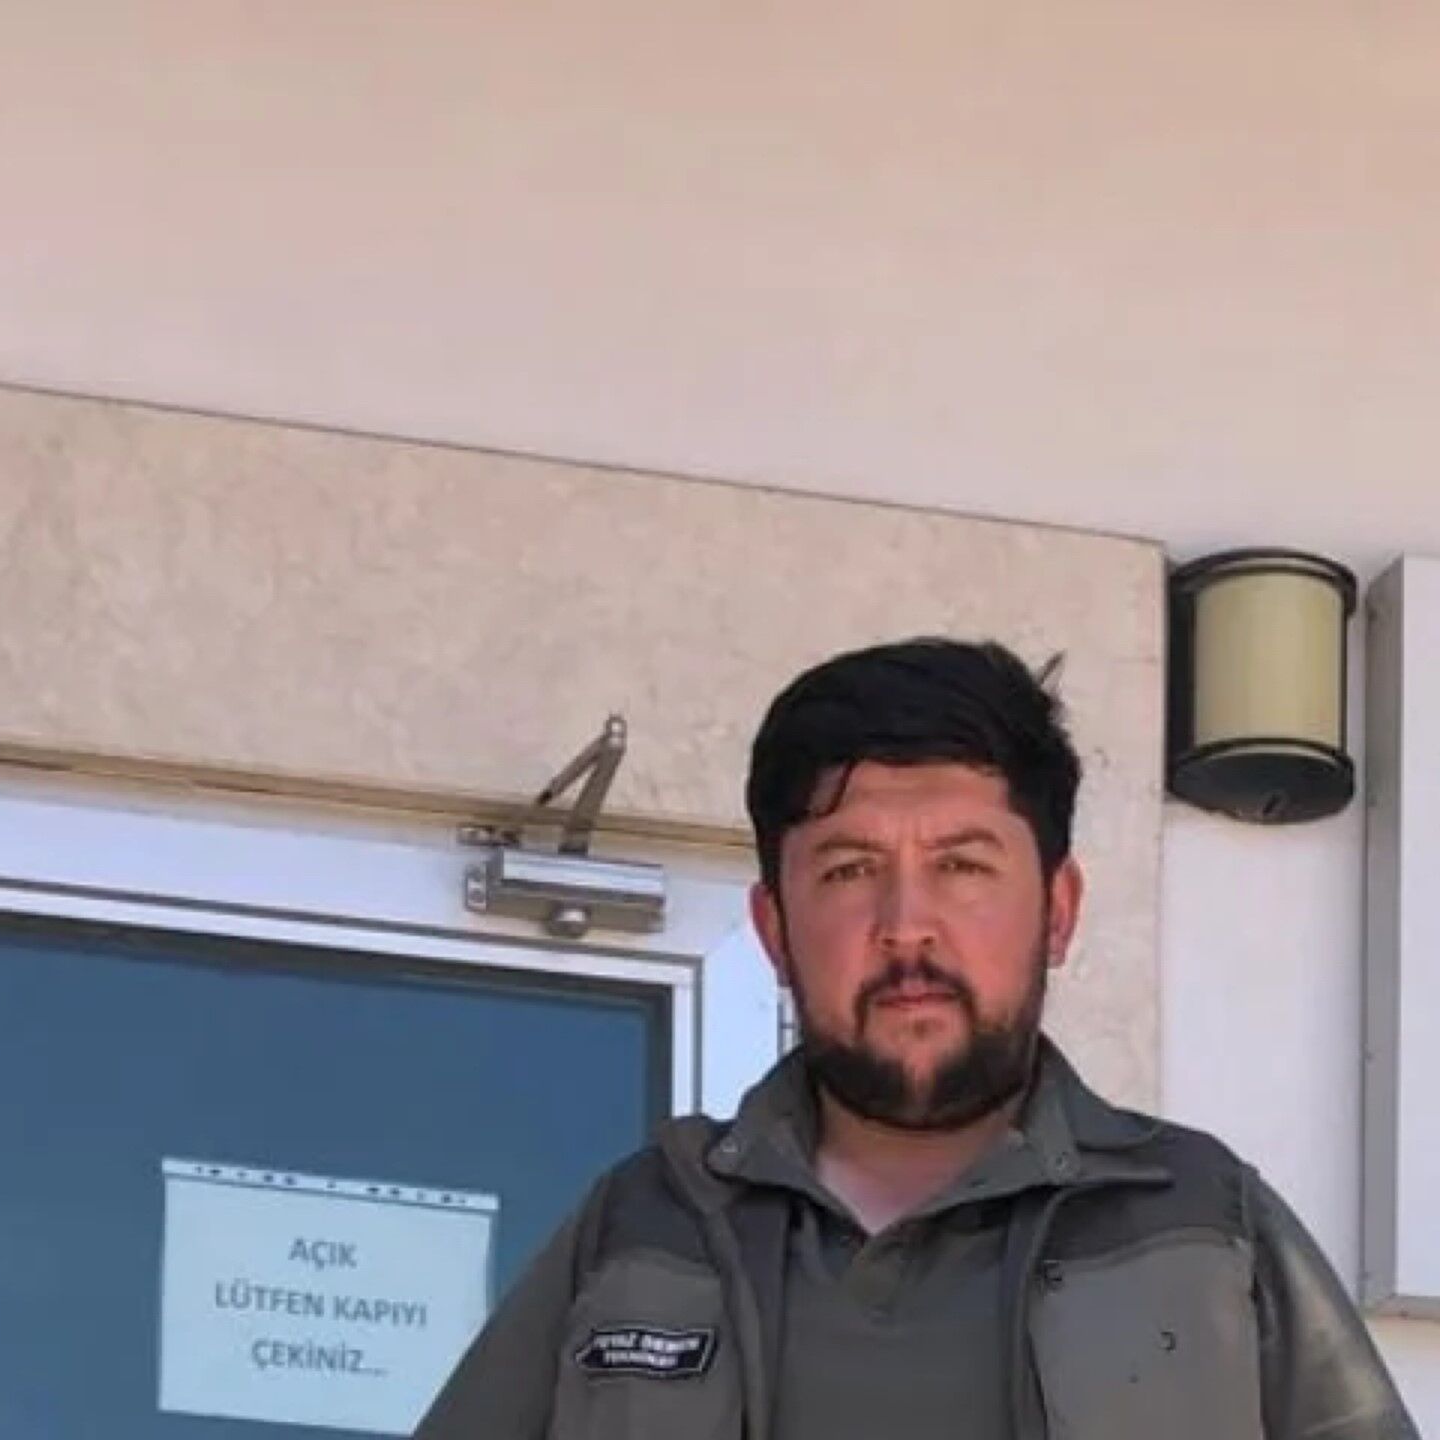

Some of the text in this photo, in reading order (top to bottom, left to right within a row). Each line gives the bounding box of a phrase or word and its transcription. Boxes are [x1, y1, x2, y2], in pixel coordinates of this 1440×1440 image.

[287, 1236, 358, 1271] AÇIK
[215, 1276, 428, 1328] LÜTFEN KAPIYI
